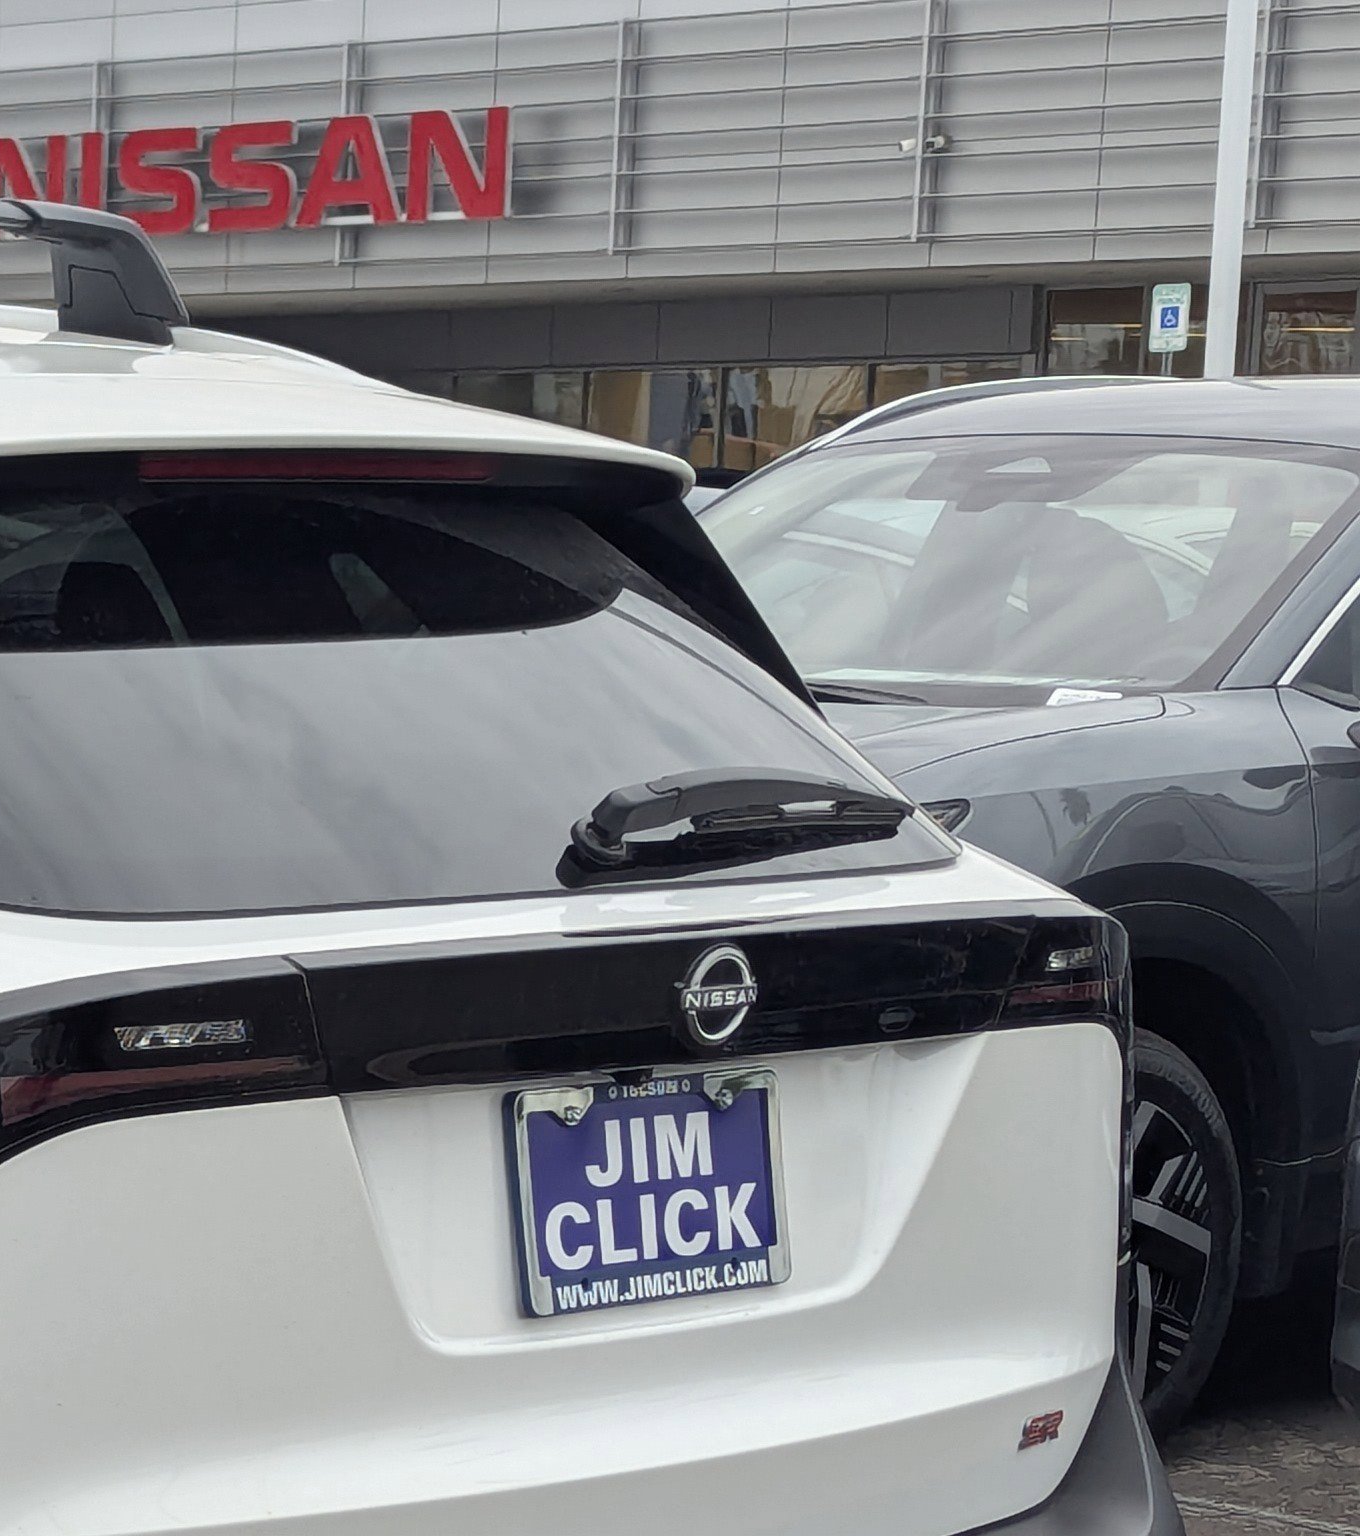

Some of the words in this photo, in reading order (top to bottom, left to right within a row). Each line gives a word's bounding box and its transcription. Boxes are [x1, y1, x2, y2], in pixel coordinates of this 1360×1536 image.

[685, 988, 757, 1008] NISSAN
[585, 1111, 714, 1188] JIM
[545, 1182, 763, 1271] CLICK
[557, 1259, 769, 1310] WWW.JIMCLICK.COM
